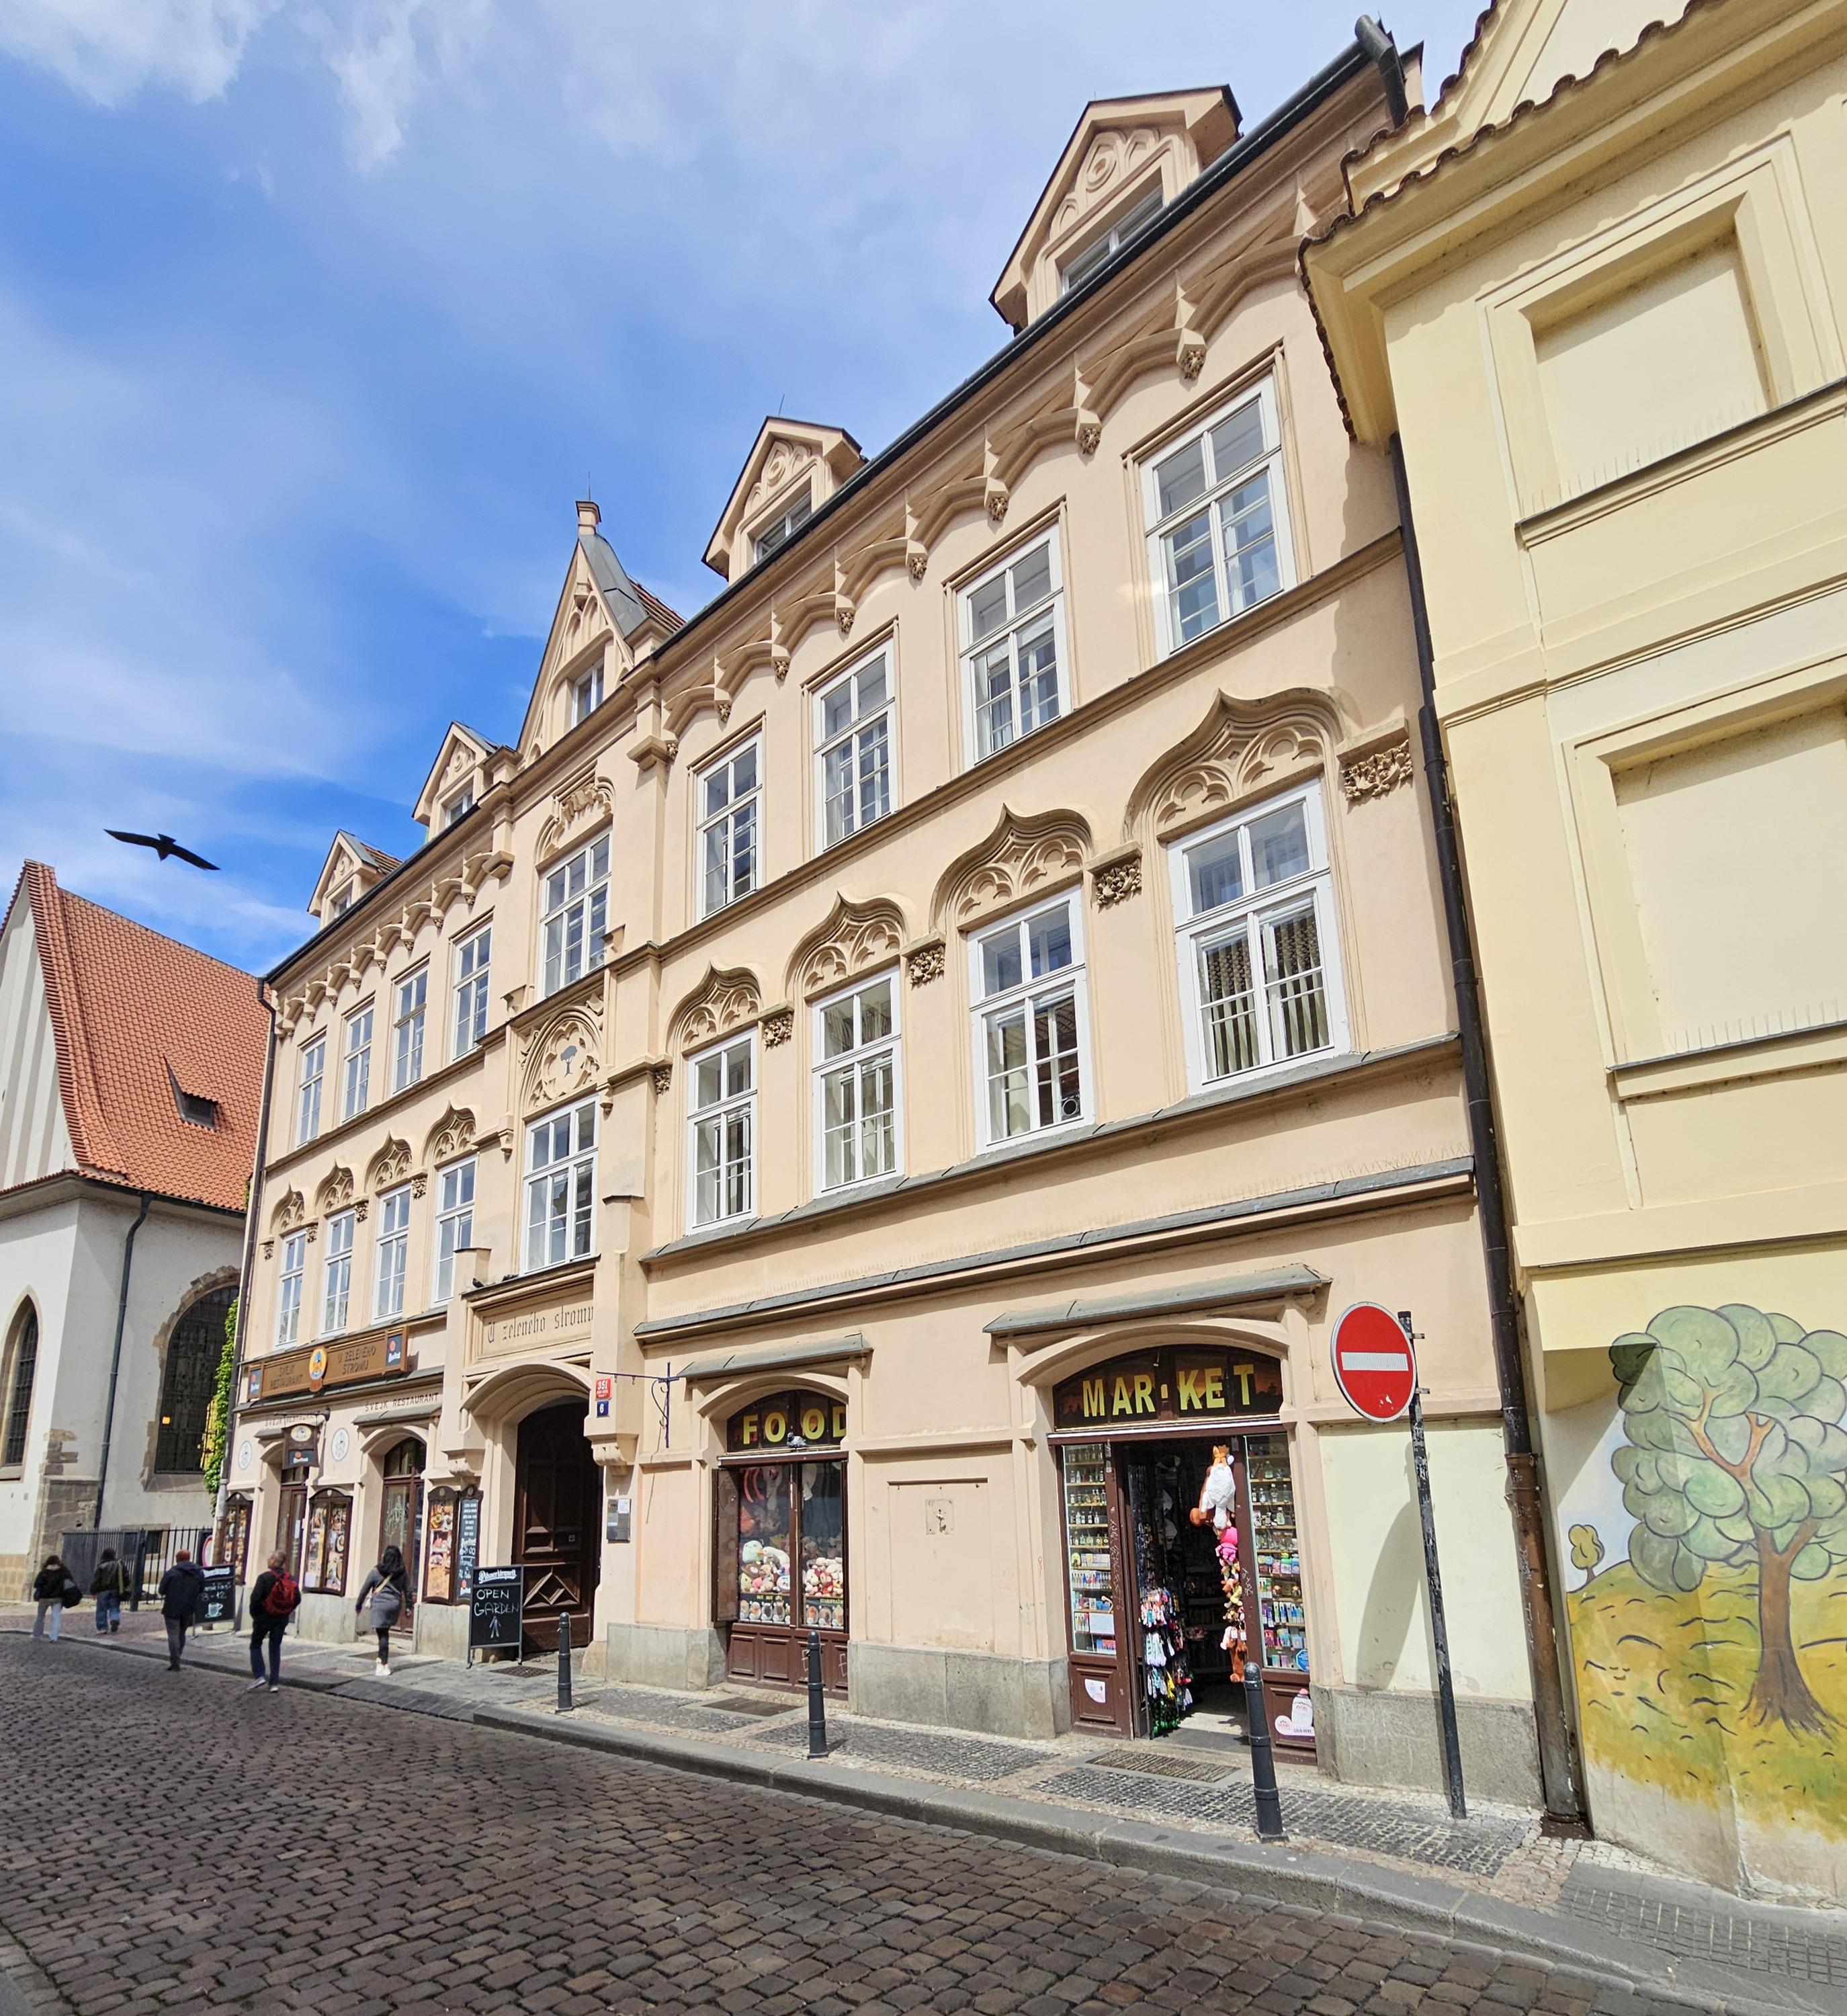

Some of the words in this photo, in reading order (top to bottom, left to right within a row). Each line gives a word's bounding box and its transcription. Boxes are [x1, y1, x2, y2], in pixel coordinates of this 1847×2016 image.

[597, 1380, 608, 1390] 351
[392, 1392, 439, 1407] RESTAURANT
[599, 1403, 605, 1414] 6
[743, 1405, 847, 1445] FOOD
[476, 1589, 509, 1600] OPEN
[474, 1602, 519, 1617] GARDEN
